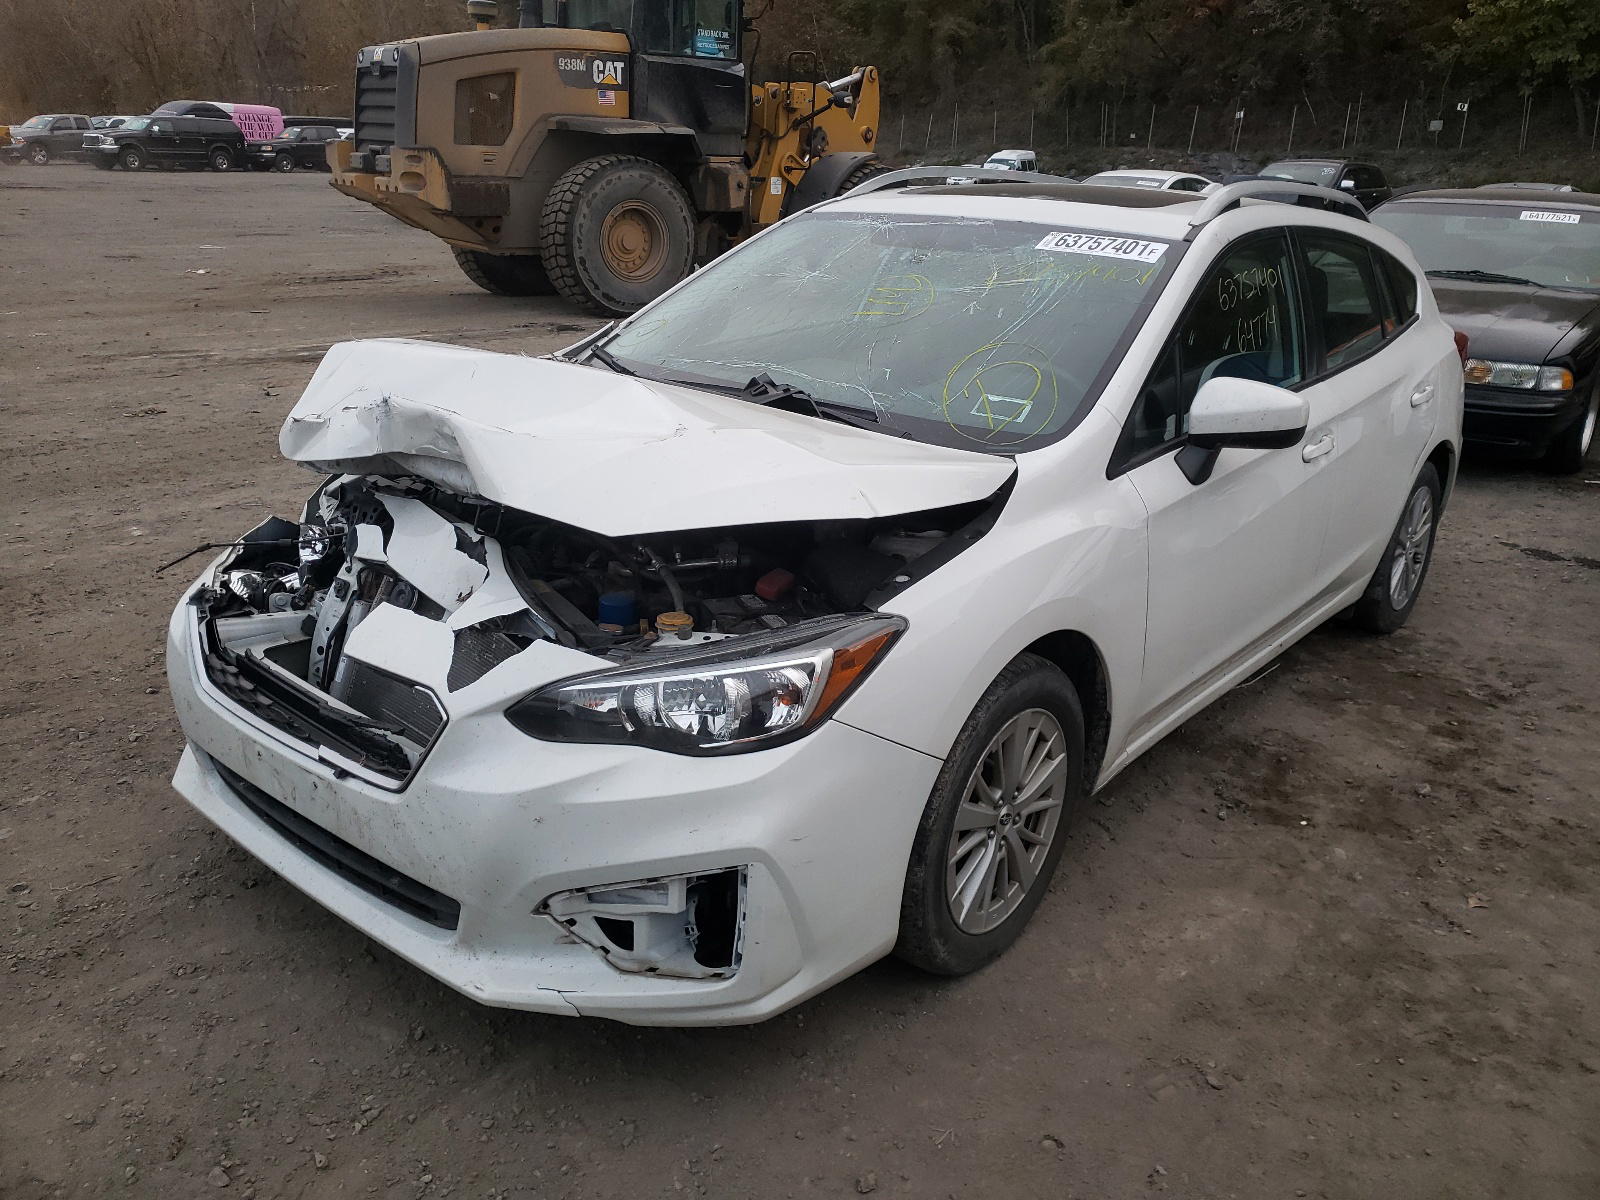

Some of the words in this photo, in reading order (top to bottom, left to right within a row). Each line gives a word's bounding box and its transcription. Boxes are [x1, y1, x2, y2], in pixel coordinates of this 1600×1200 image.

[558, 57, 587, 72] 938M
[592, 59, 625, 86] CAT
[238, 113, 272, 123] CHANGE
[238, 122, 256, 131] THE
[257, 123, 274, 132] WAY
[243, 131, 256, 139] OU
[258, 131, 275, 140] GET
[1217, 264, 1286, 312] 63757401
